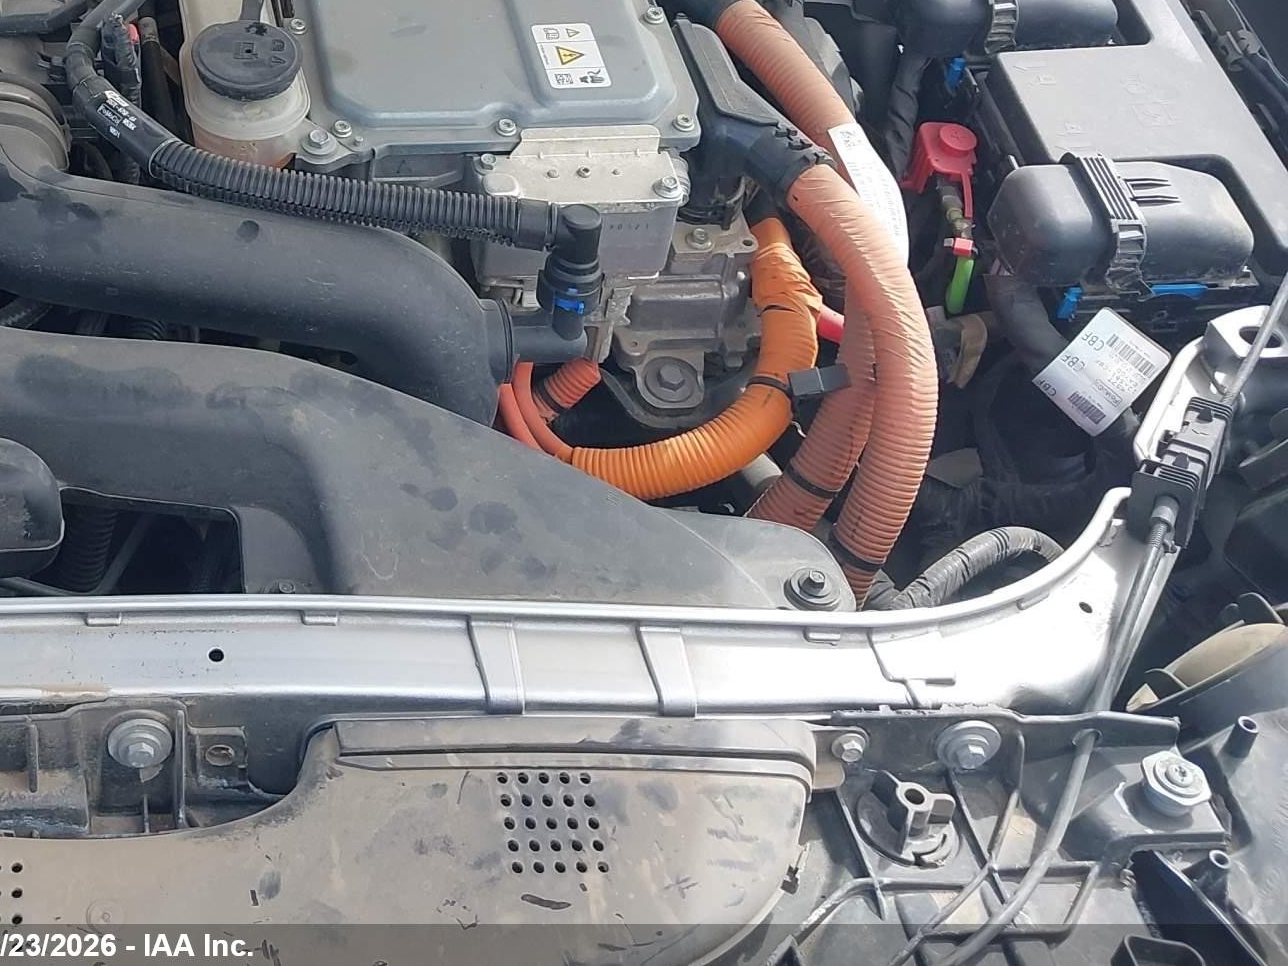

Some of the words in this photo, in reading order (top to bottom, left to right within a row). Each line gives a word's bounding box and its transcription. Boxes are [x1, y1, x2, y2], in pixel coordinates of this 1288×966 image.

[1081, 333, 1105, 351] CBF
[1061, 354, 1085, 372] CBF
[1036, 380, 1057, 398] CBF
